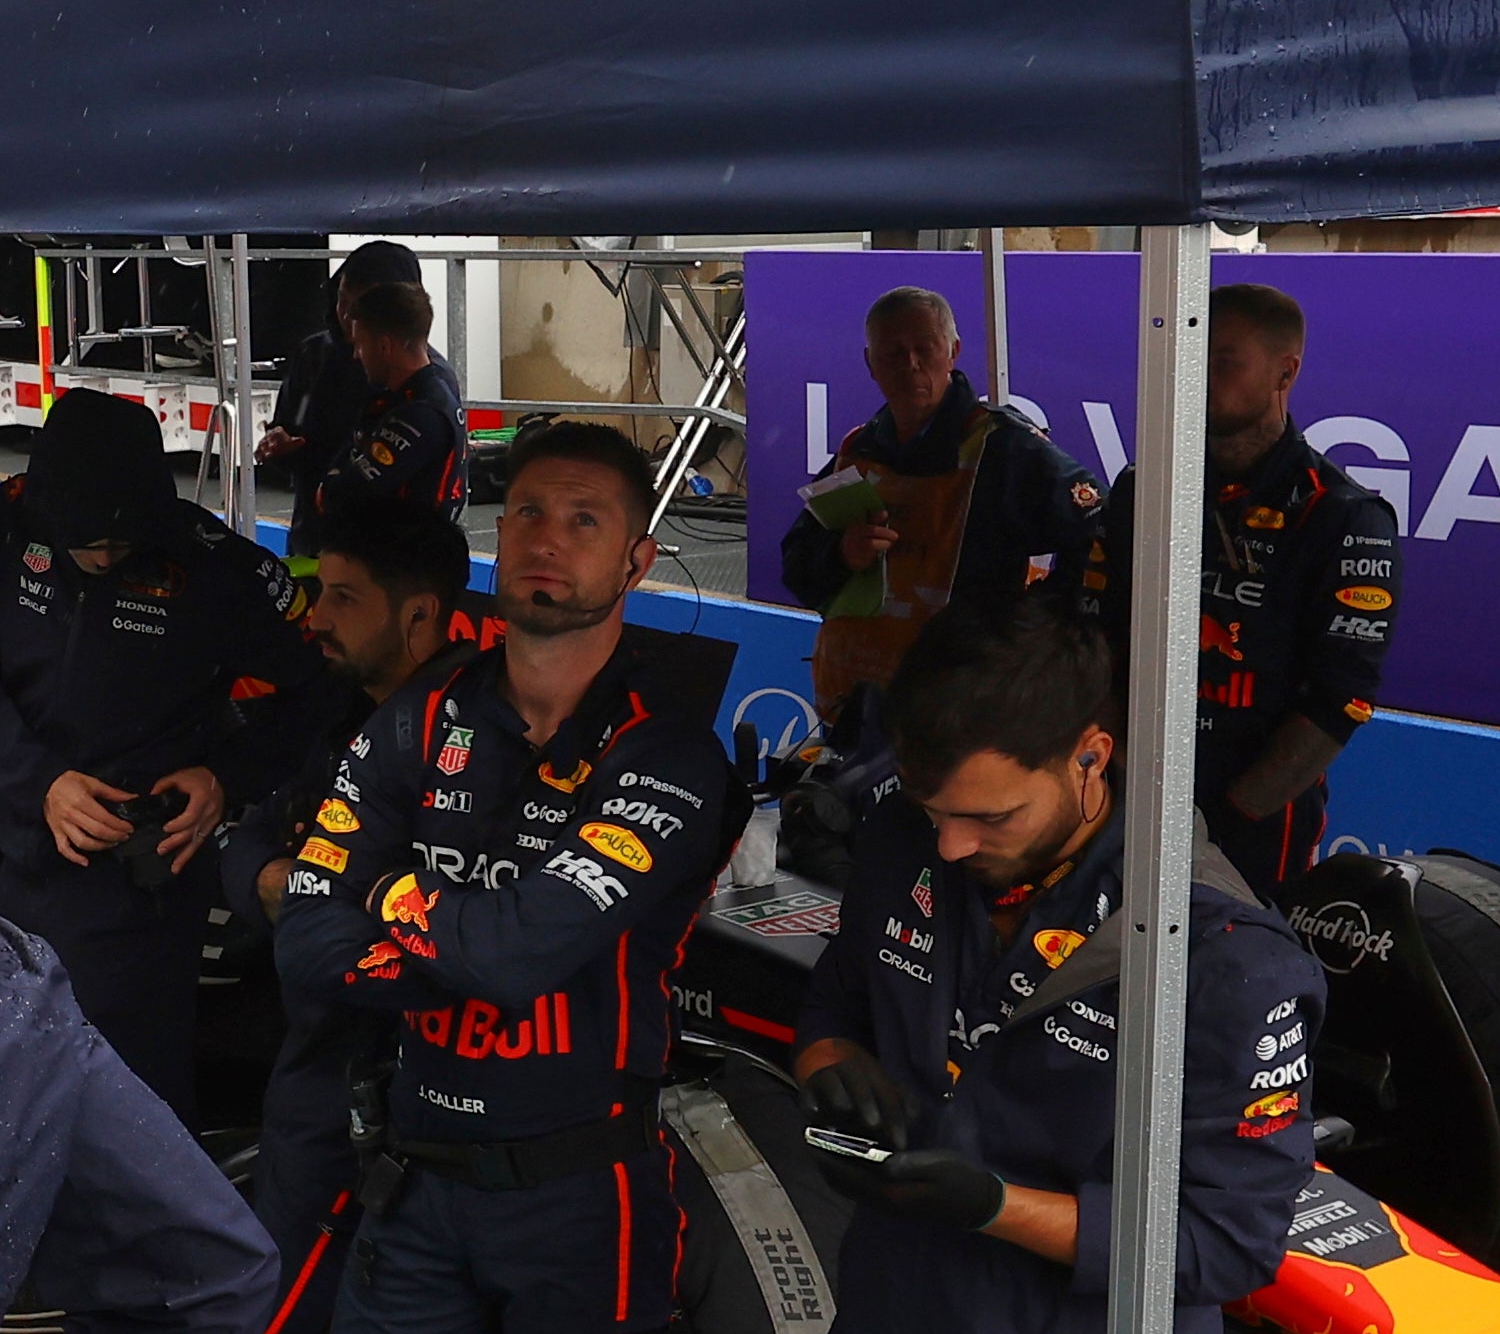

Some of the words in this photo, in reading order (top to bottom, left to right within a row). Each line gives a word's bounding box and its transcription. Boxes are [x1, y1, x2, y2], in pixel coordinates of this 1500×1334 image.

[1340, 558, 1392, 578] ROKT
[115, 599, 168, 617] HONDA
[1352, 589, 1387, 605] RAUCH
[123, 619, 166, 636] Gate.io
[1329, 614, 1389, 639] HRC
[639, 775, 704, 810] 1Password
[601, 797, 684, 840] ROKT
[287, 870, 331, 896] VISA
[545, 849, 630, 908] HRC
[738, 894, 826, 921] TAG
[885, 917, 934, 954] Mobil
[1278, 1021, 1303, 1053] AT&T
[1250, 1053, 1309, 1090] ROKT
[428, 1088, 486, 1115] CALLER
[1303, 1220, 1371, 1258] Mobil
[755, 1227, 804, 1322] Front
[779, 1227, 825, 1323] Right
